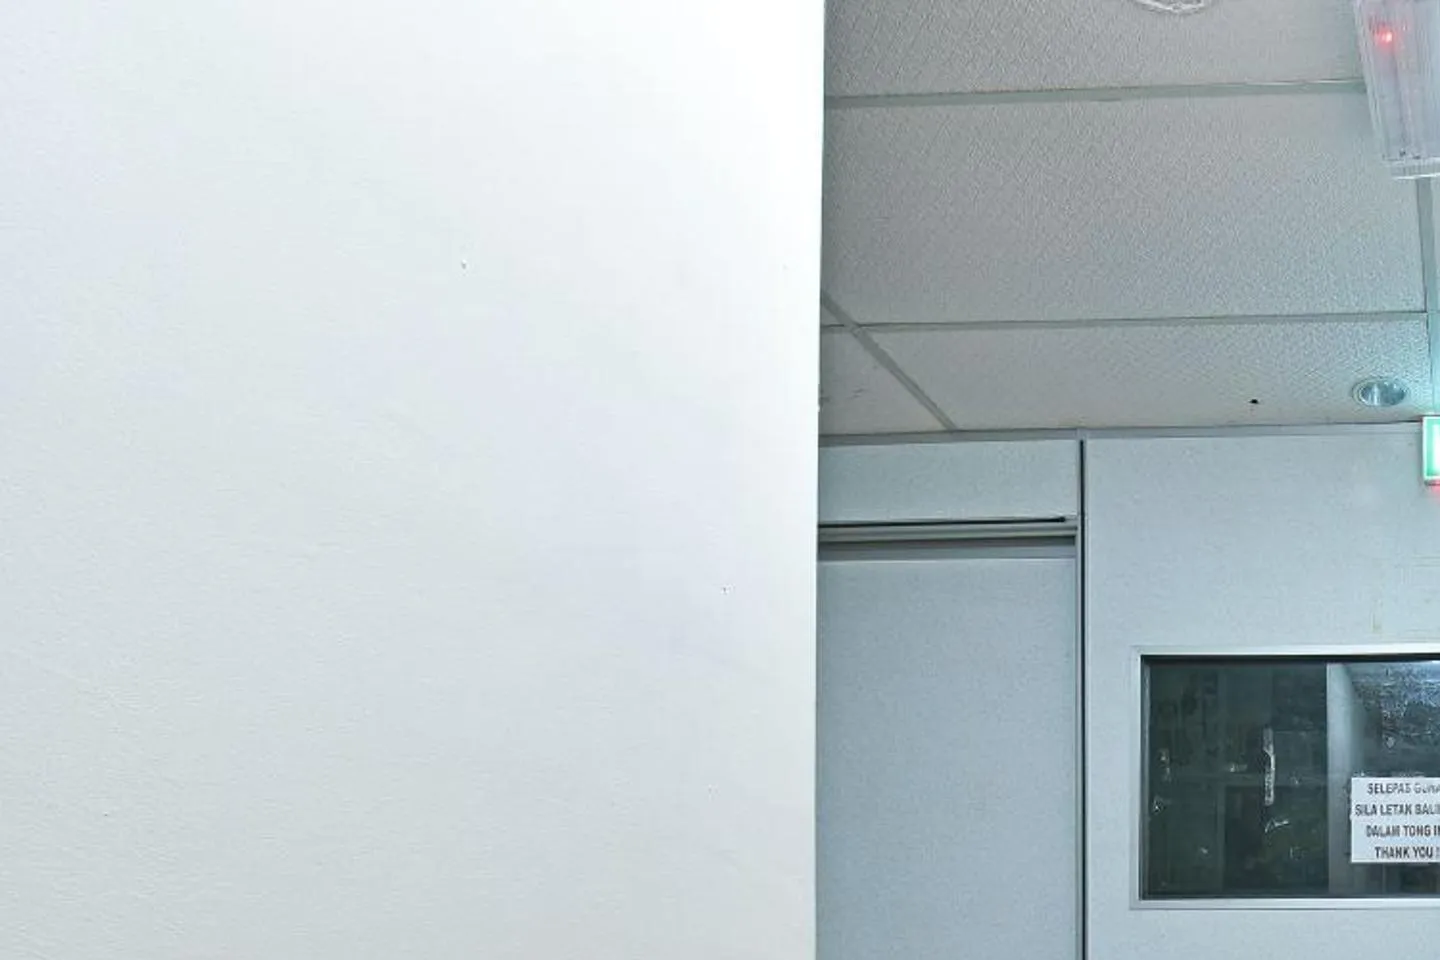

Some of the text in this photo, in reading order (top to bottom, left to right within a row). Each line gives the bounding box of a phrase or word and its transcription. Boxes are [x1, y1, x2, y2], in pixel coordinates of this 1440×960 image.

[1367, 783, 1411, 794] SELEPAS
[1355, 804, 1377, 816] SILA
[1380, 803, 1412, 815] LETAK
[1366, 825, 1400, 837] DALAM
[1403, 825, 1431, 837] TONG
[1375, 846, 1410, 858] THANK
